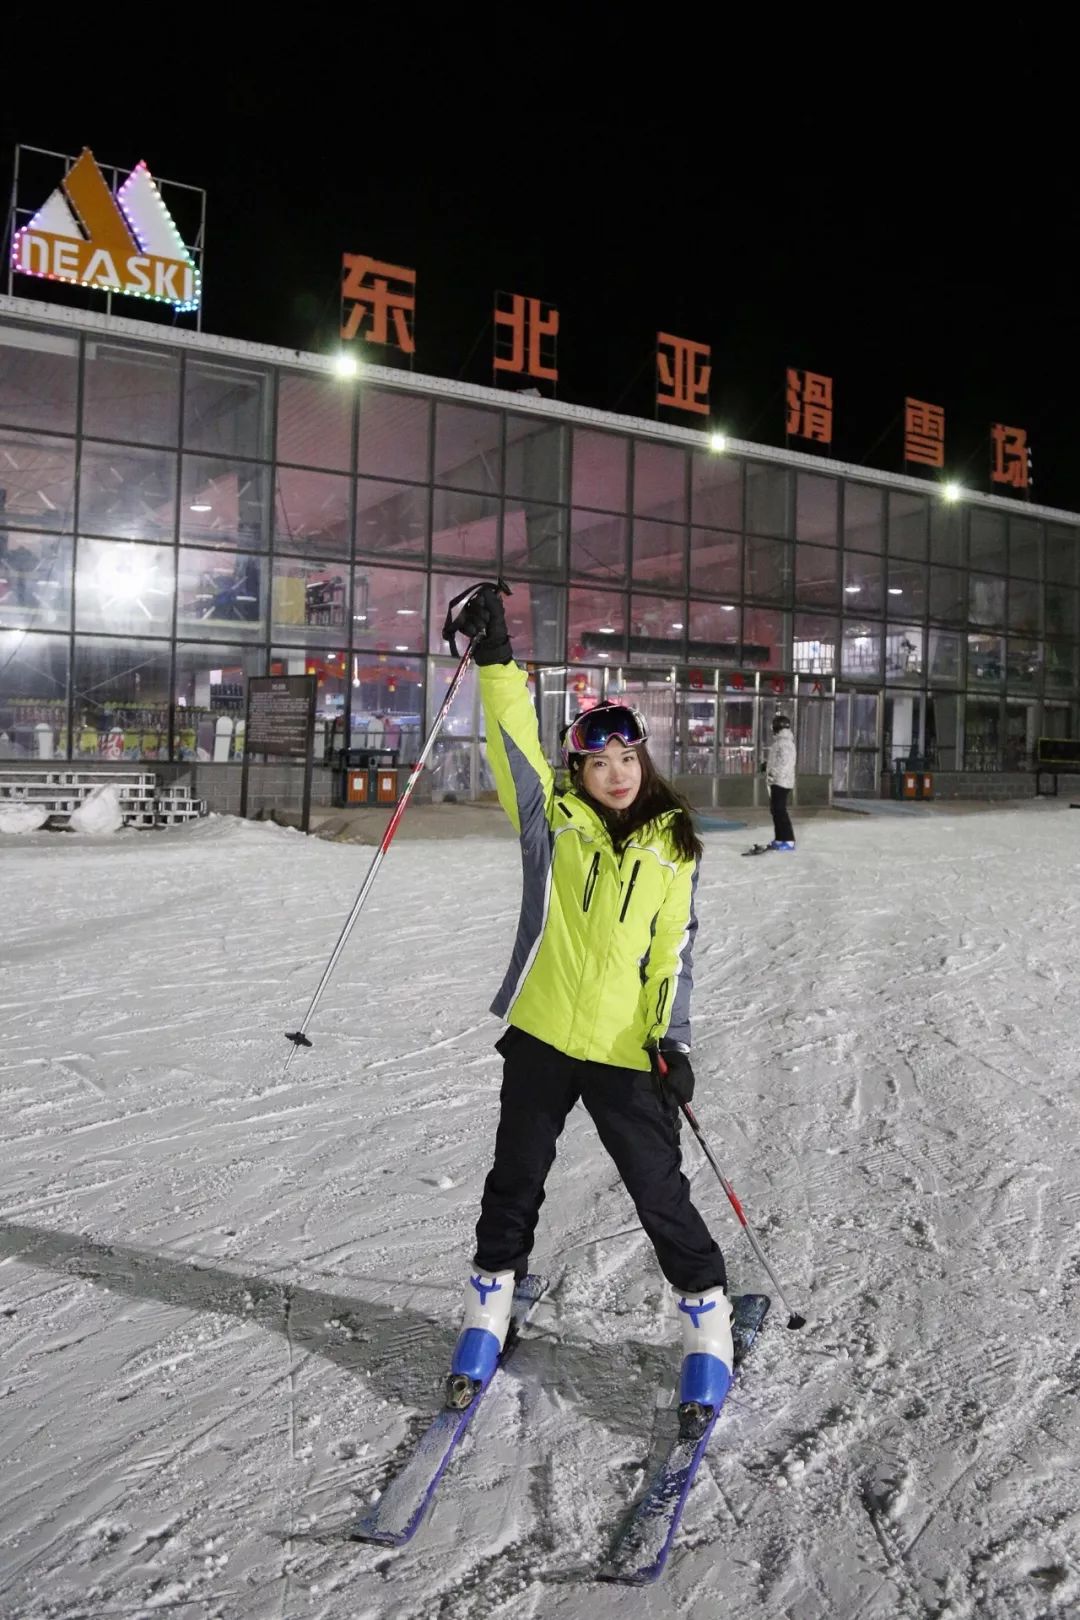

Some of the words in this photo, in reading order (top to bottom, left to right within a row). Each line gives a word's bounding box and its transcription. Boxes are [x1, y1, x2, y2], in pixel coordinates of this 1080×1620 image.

[340, 252, 1028, 488] 东北亚滑雪场
